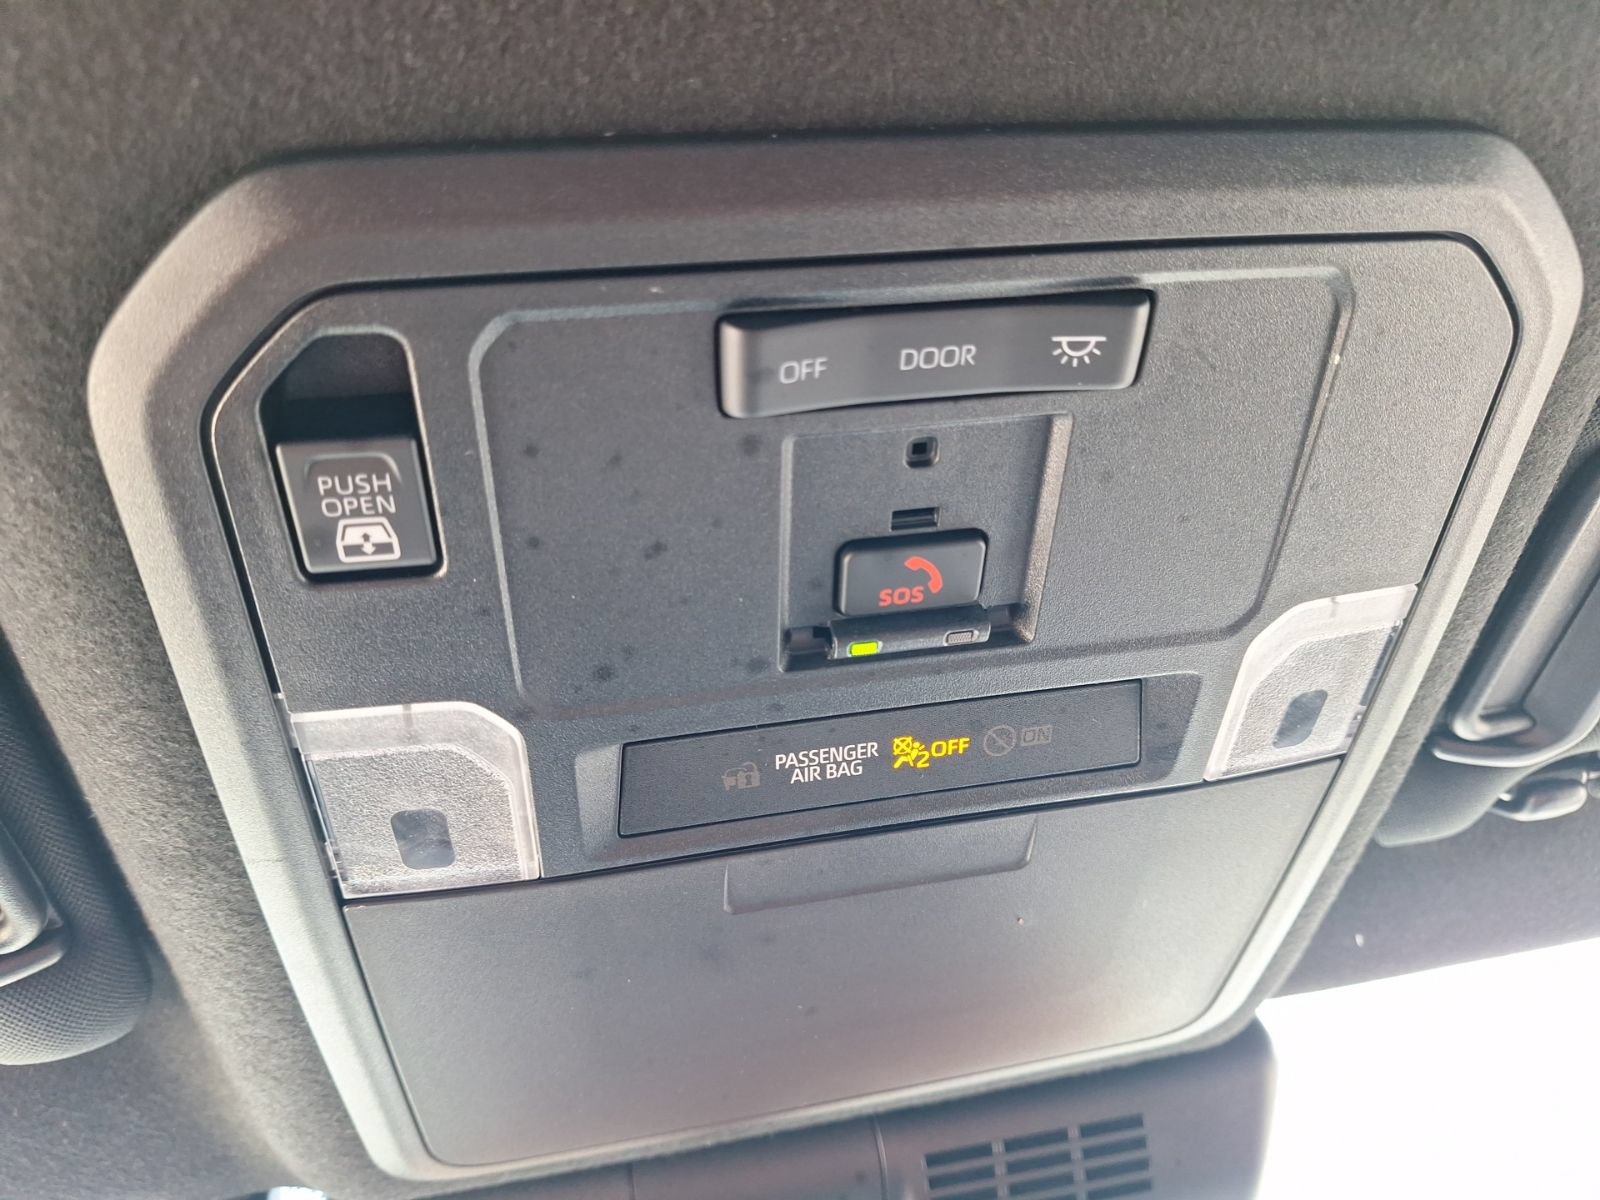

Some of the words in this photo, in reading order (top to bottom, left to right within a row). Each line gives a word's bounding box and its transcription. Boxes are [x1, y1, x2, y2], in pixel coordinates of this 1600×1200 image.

[899, 344, 977, 371] DOOR
[778, 357, 828, 385] OFF
[317, 472, 393, 496] PUSH
[321, 495, 396, 518] OPEN
[878, 586, 925, 608] SOS
[931, 737, 971, 757] OFF
[1022, 726, 1052, 745] ON
[775, 742, 879, 770] PASSENGER
[790, 766, 822, 784] AIR
[826, 760, 863, 779] BAG
